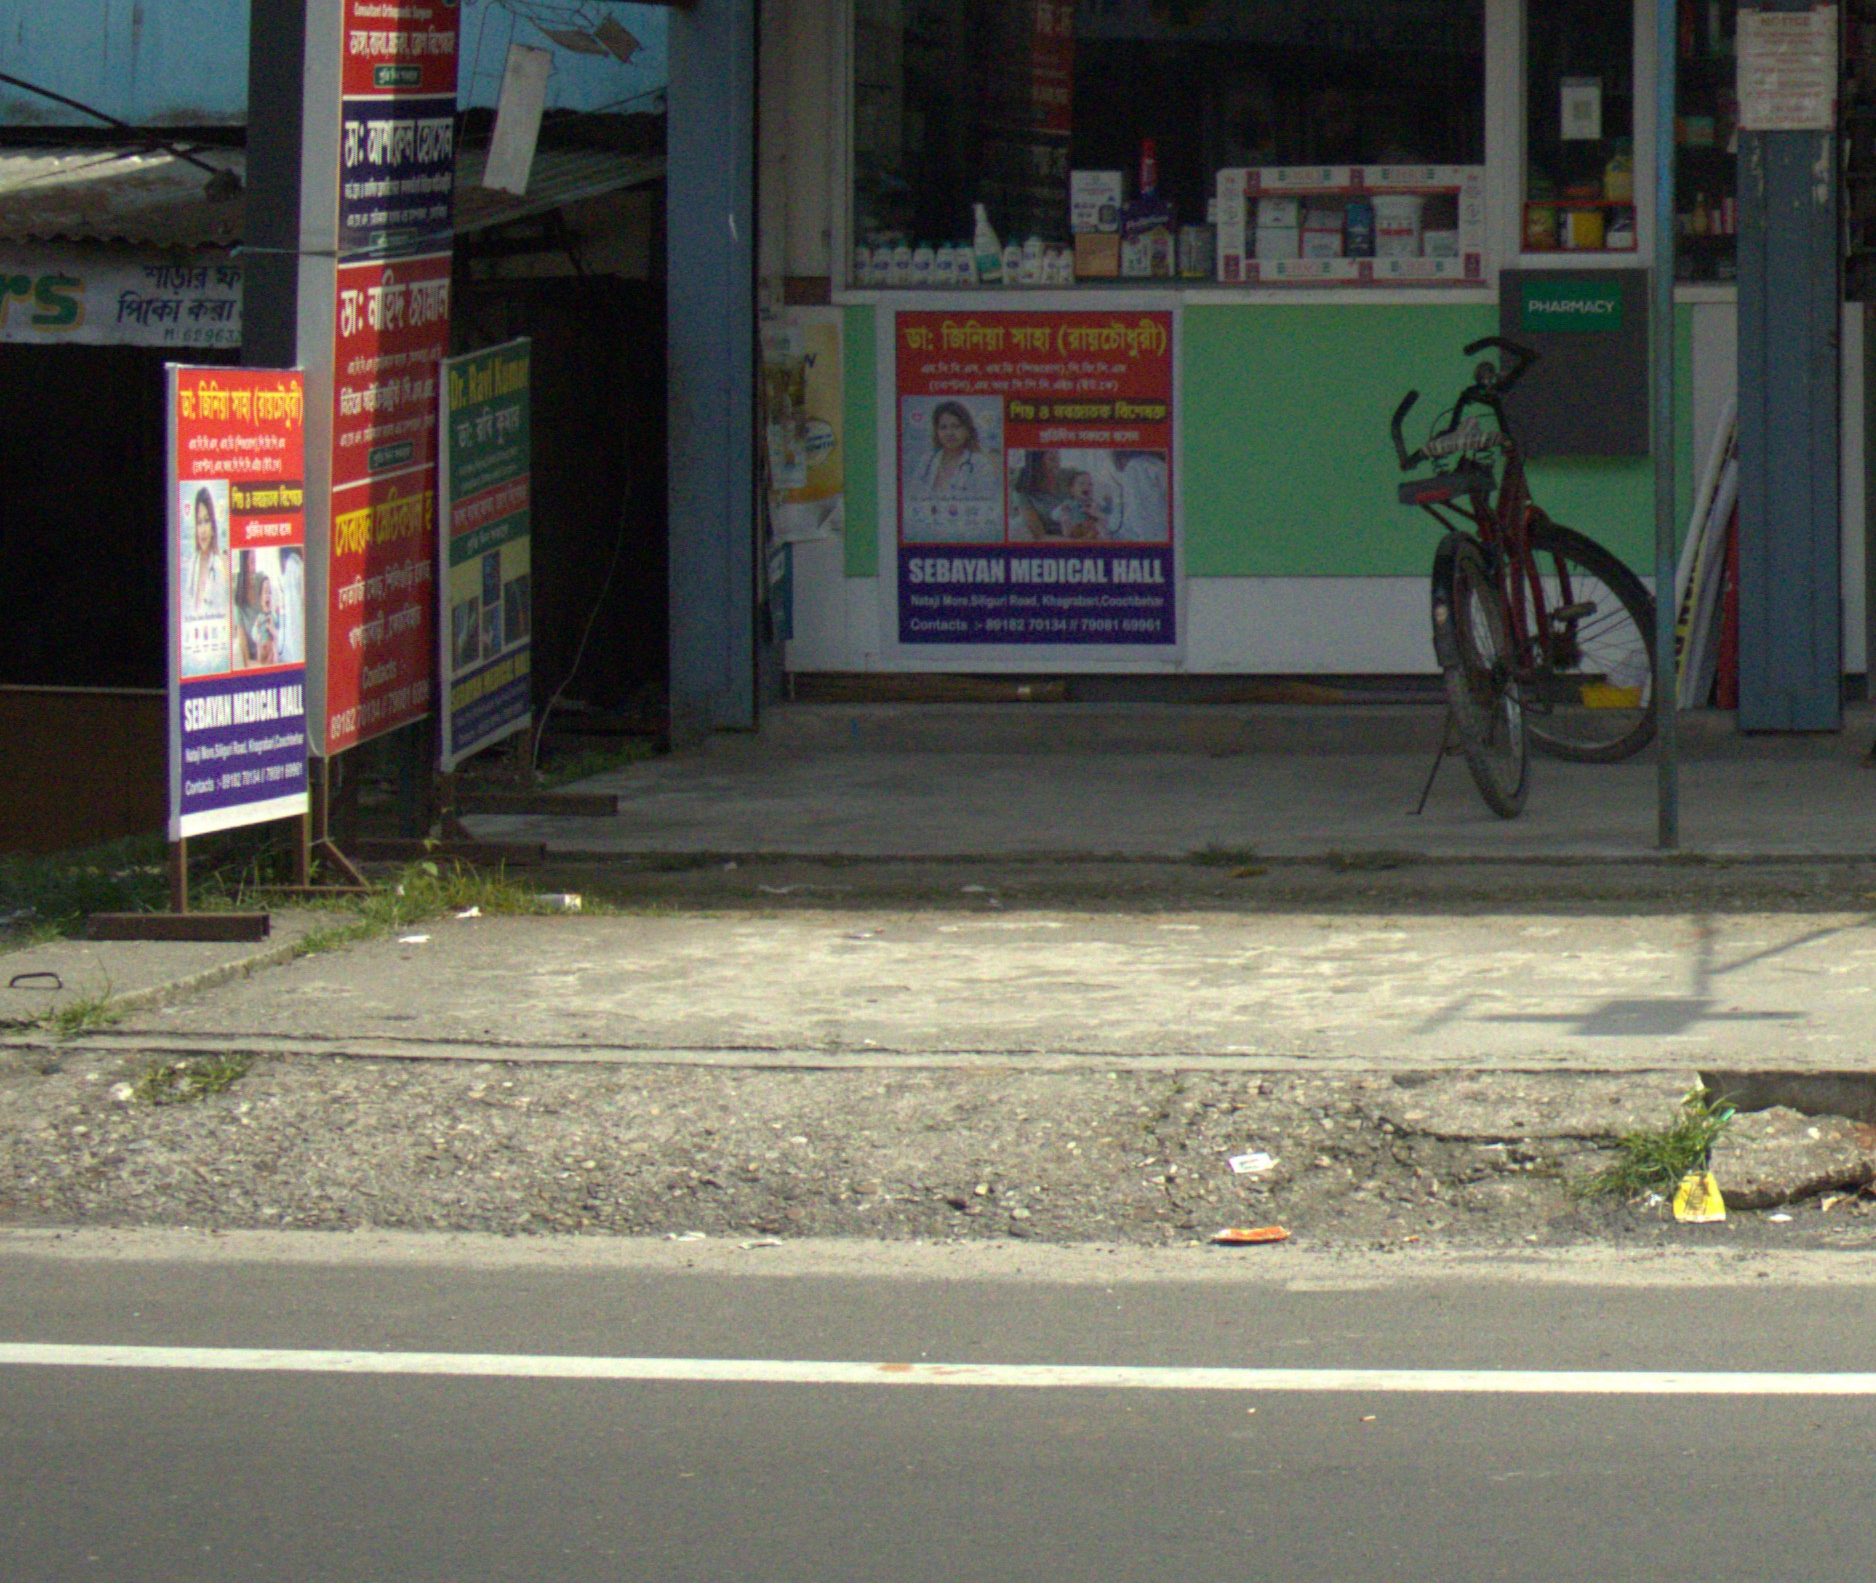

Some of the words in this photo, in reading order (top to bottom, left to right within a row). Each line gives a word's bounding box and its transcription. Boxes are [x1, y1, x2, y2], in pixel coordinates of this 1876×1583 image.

[1528, 300, 1615, 314] PHARMACY
[909, 557, 1005, 584] SEBAYAN
[1010, 557, 1107, 584] MEDICAL
[1112, 557, 1165, 584] HALL
[185, 696, 232, 732] SEBAYAN
[234, 688, 278, 724] MEDICAL
[280, 683, 304, 717] HALL
